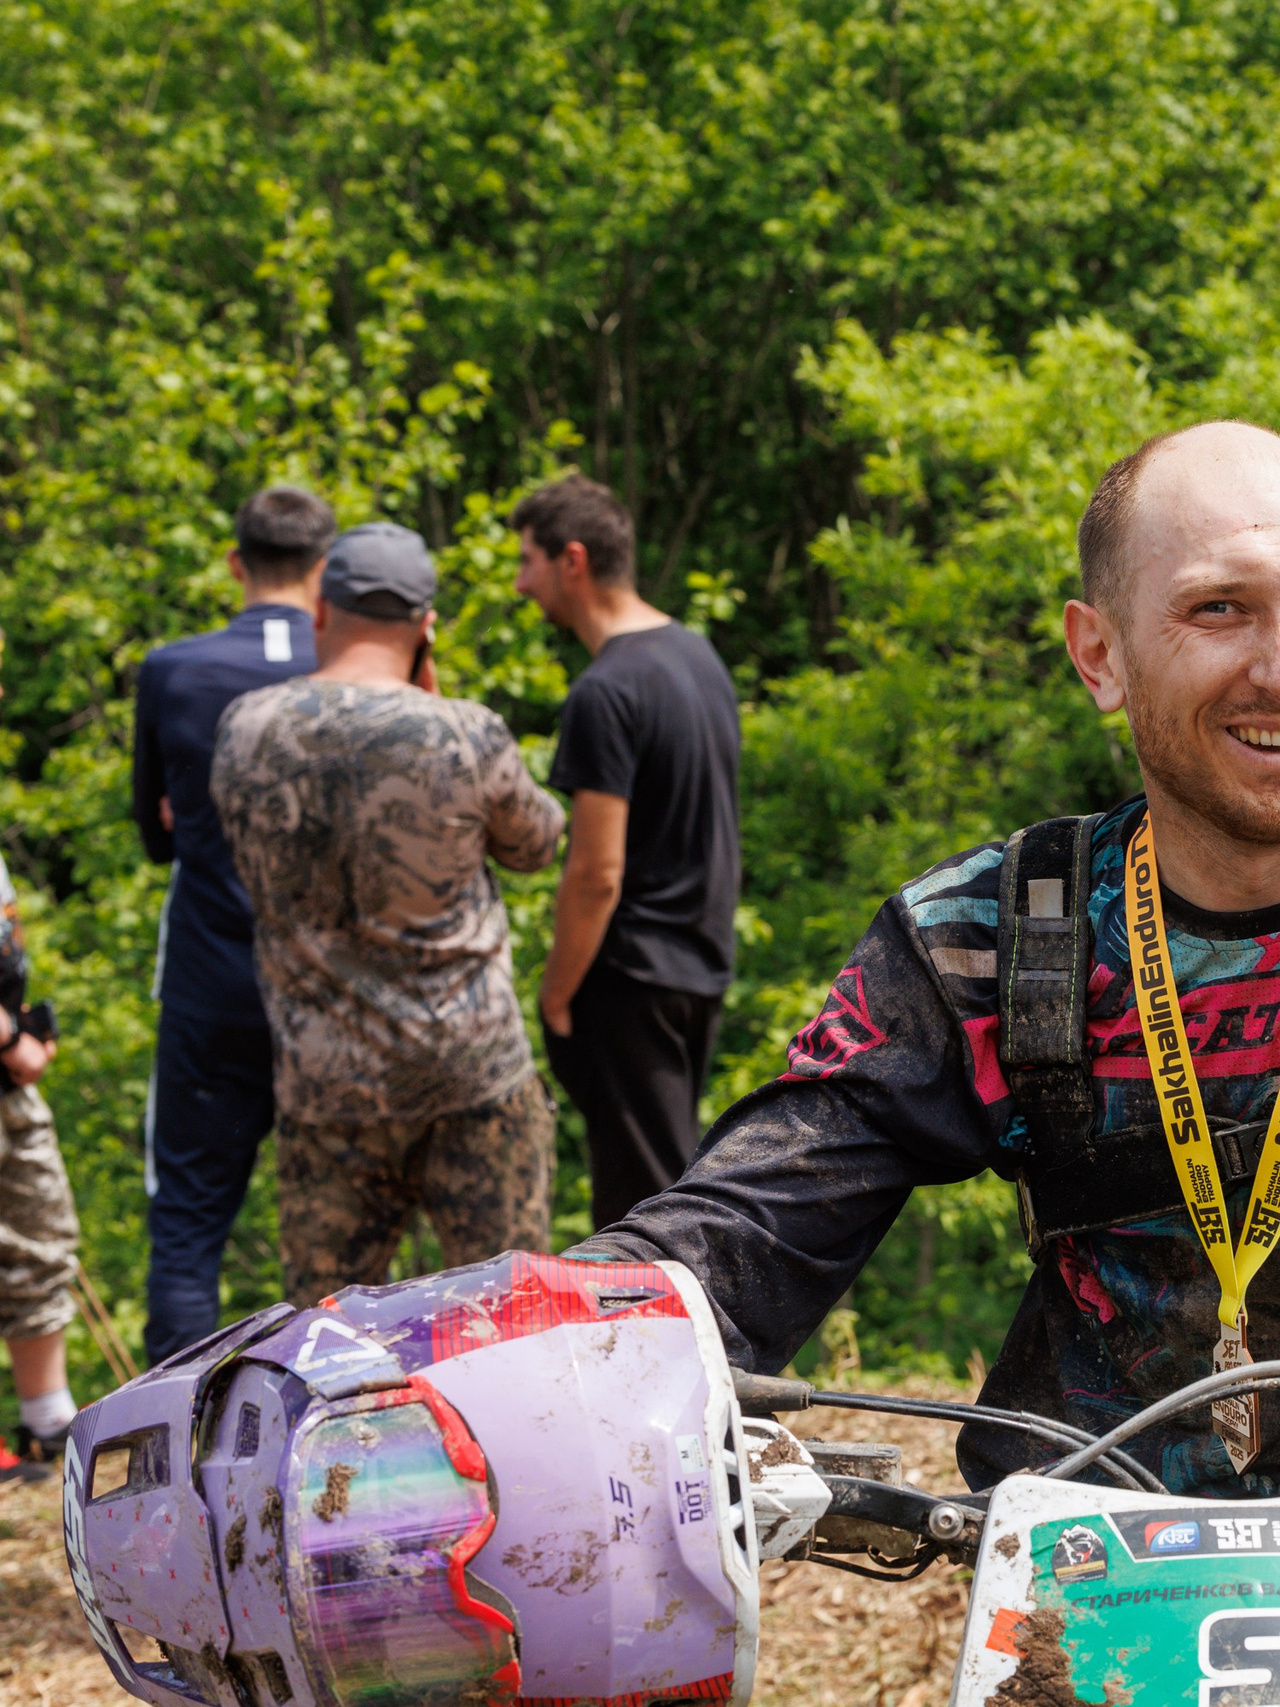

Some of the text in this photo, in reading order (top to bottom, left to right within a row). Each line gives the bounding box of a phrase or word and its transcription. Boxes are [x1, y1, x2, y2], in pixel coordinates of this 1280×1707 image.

[1130, 819, 1201, 1146] SakhalinEnduroTV
[1186, 1158, 1203, 1204] SAKHALIN
[1195, 1164, 1209, 1203] ENDURO
[1201, 1164, 1216, 1203] TROPHY
[1213, 1400, 1248, 1427] ENDURO
[684, 1480, 705, 1523] DOT
